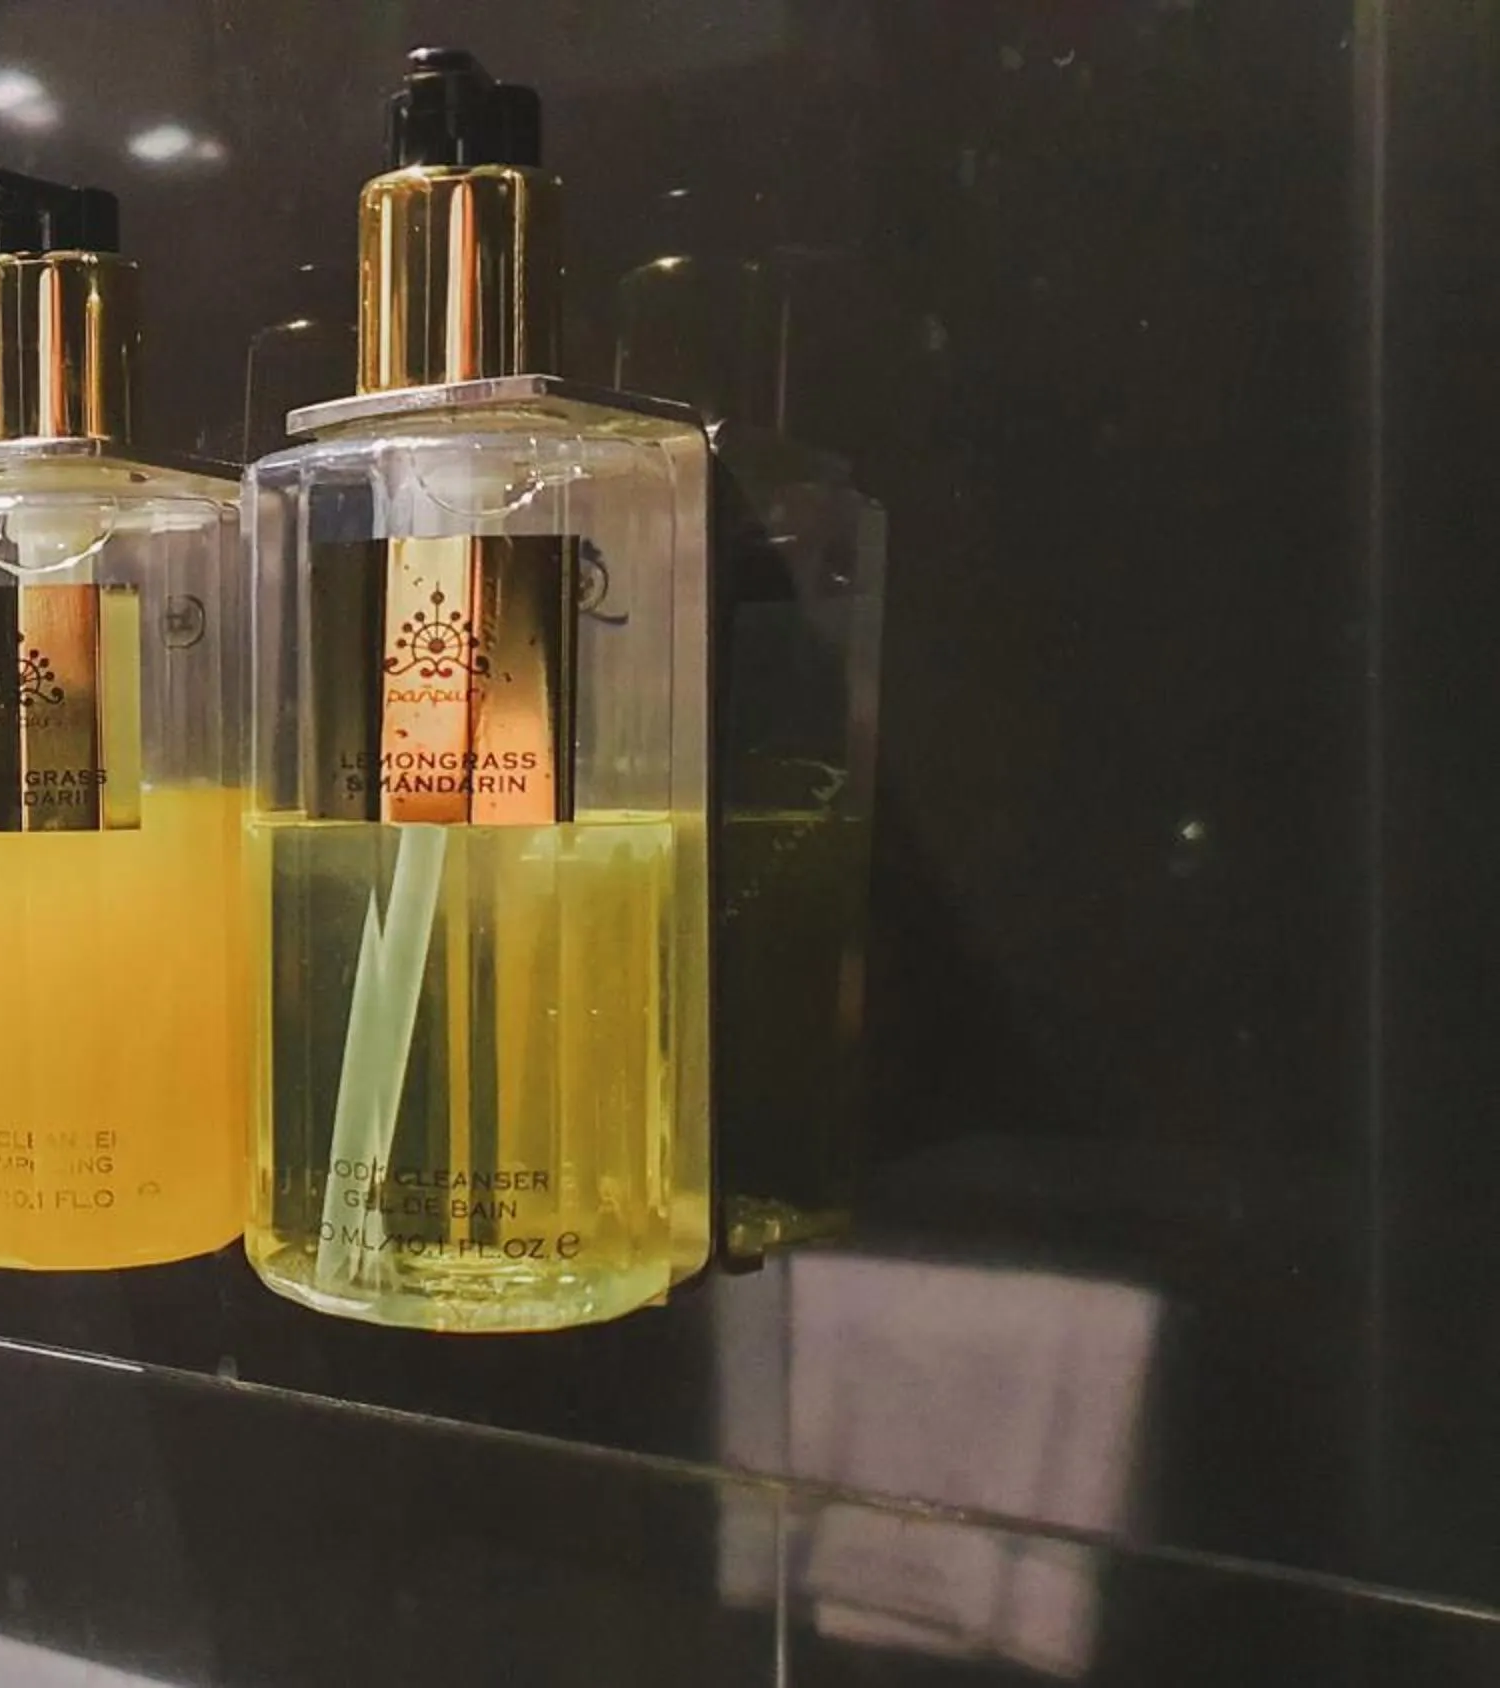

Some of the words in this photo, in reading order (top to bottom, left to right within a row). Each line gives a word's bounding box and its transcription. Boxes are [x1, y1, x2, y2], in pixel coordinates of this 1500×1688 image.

[341, 751, 536, 770] LEMONGRASS
[376, 774, 527, 794] MANDARIN
[395, 1167, 549, 1192] CLEANSER
[451, 1198, 517, 1219] BAIN
